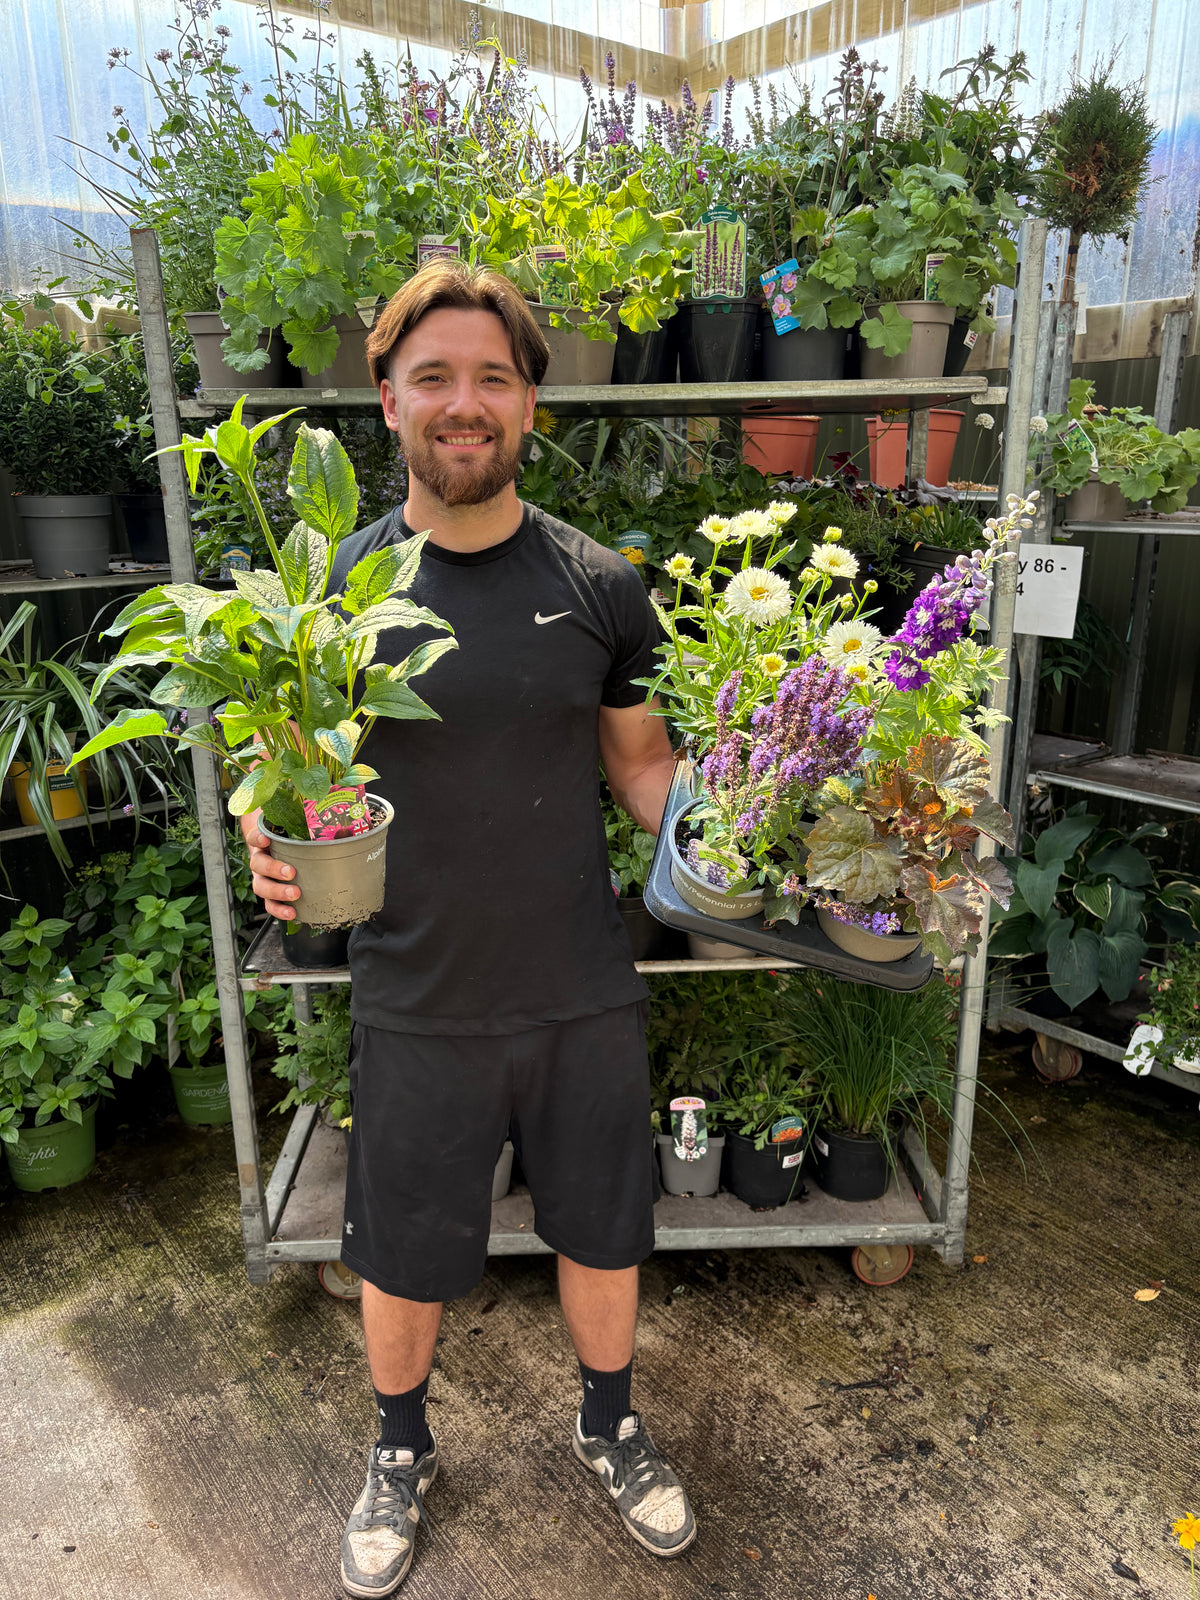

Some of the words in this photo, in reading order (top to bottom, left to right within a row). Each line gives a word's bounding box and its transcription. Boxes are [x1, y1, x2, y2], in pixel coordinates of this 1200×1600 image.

[1017, 560, 1028, 574] y
[1034, 558, 1055, 573] 86
[1016, 582, 1025, 596] 4
[28, 1146, 57, 1166] ghts
